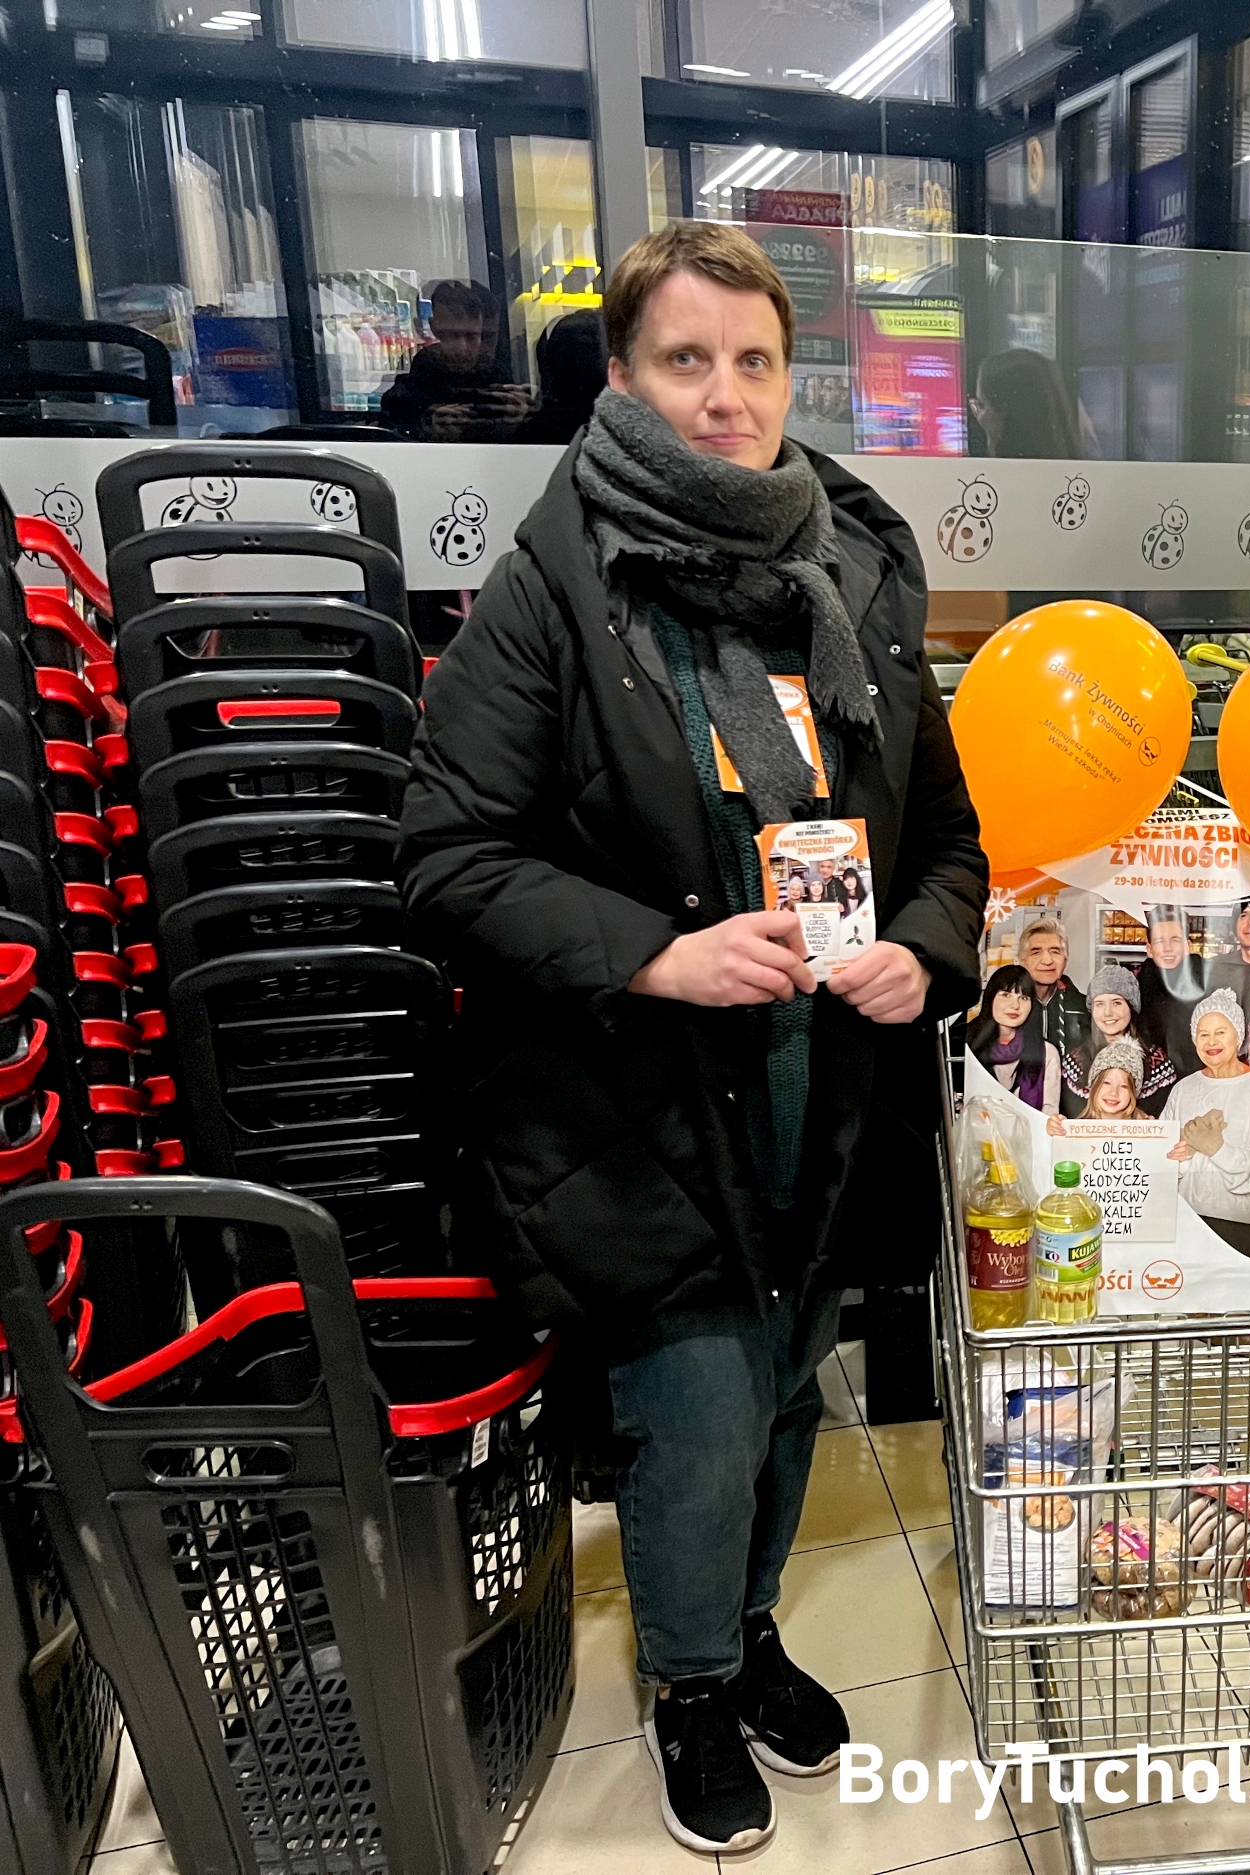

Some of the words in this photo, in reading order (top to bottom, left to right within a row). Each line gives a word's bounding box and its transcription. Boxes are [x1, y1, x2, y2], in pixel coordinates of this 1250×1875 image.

[1048, 659, 1086, 689] Bank
[1087, 680, 1146, 736] Żywności
[1097, 714, 1132, 749] Chojnicach
[1048, 735, 1074, 757] Wielka
[1144, 813, 1232, 825] OMOŻESZ
[1110, 839, 1239, 870] ŻYWNOŚCI
[1114, 876, 1144, 887] 29-30
[1145, 876, 1196, 890] listopada
[1197, 880, 1224, 889] 2024
[1069, 1125, 1118, 1134] POTRZEBNE
[1121, 1125, 1164, 1134] PRODUKTY
[1102, 1141, 1133, 1155] OLEJ
[1092, 1158, 1142, 1172] CUKIER
[1083, 1174, 1150, 1188] SŁODYCZE
[1086, 1189, 1150, 1204] ONSERWY
[1102, 1205, 1143, 1219] KALIE
[1103, 1222, 1132, 1235] ŻEM
[1072, 1238, 1101, 1260] KUJAW
[1097, 1269, 1132, 1290] ości
